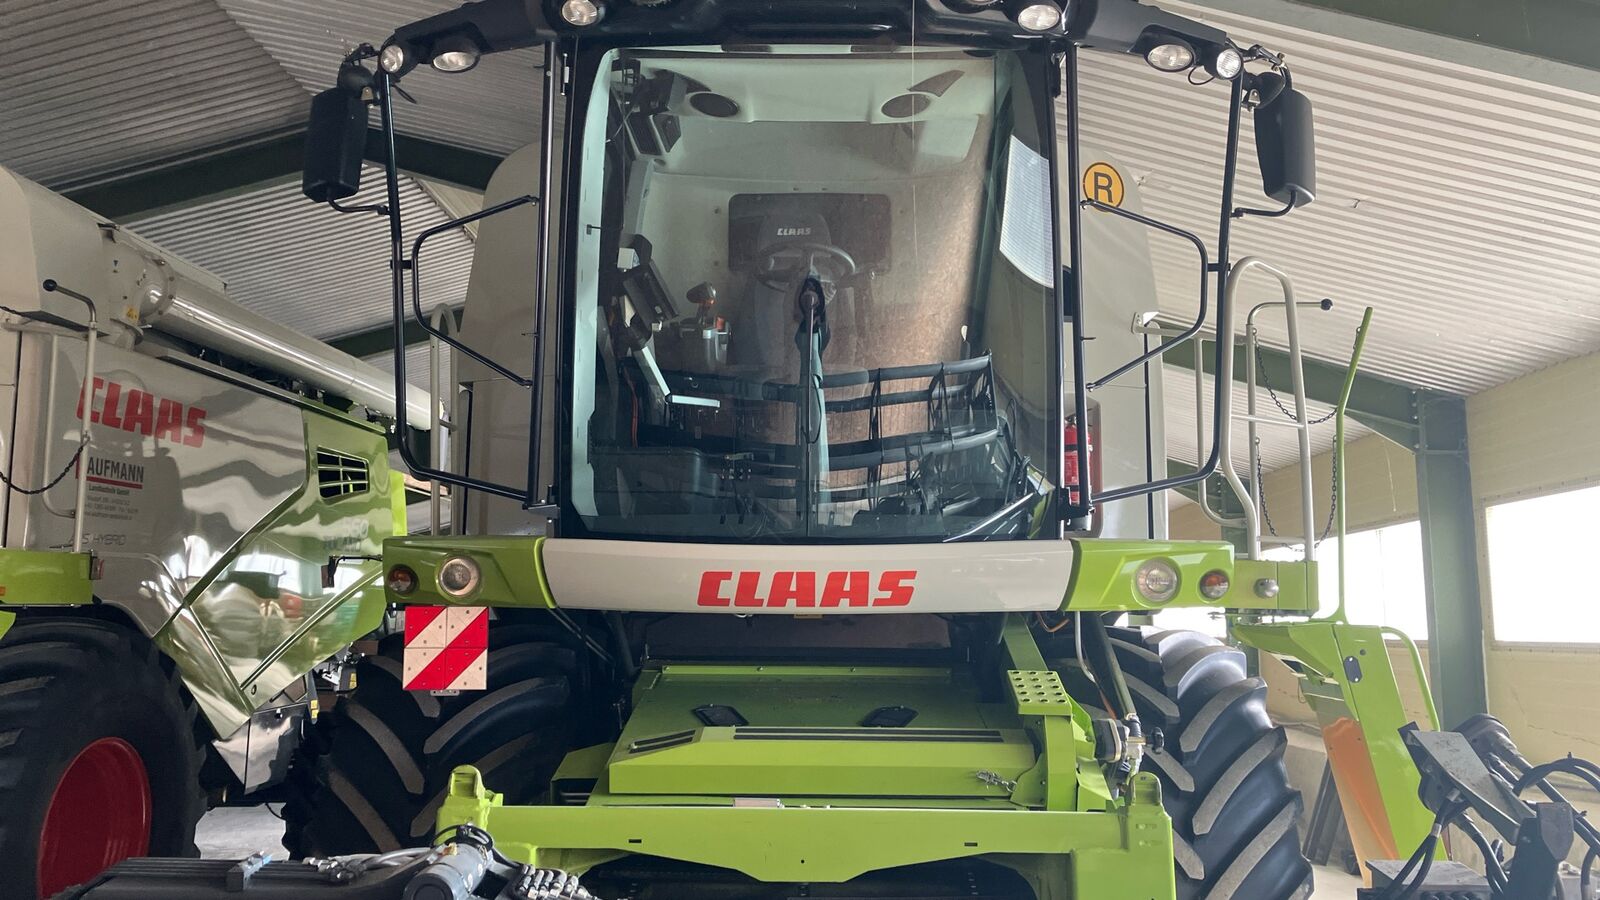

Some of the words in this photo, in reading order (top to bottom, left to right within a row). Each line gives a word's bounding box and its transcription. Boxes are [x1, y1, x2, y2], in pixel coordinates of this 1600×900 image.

[1094, 171, 1113, 203] R
[777, 227, 811, 236] CLAAS
[77, 376, 206, 448] CLAAS
[83, 457, 144, 483] AUFMANN
[697, 570, 917, 608] CLAAS
